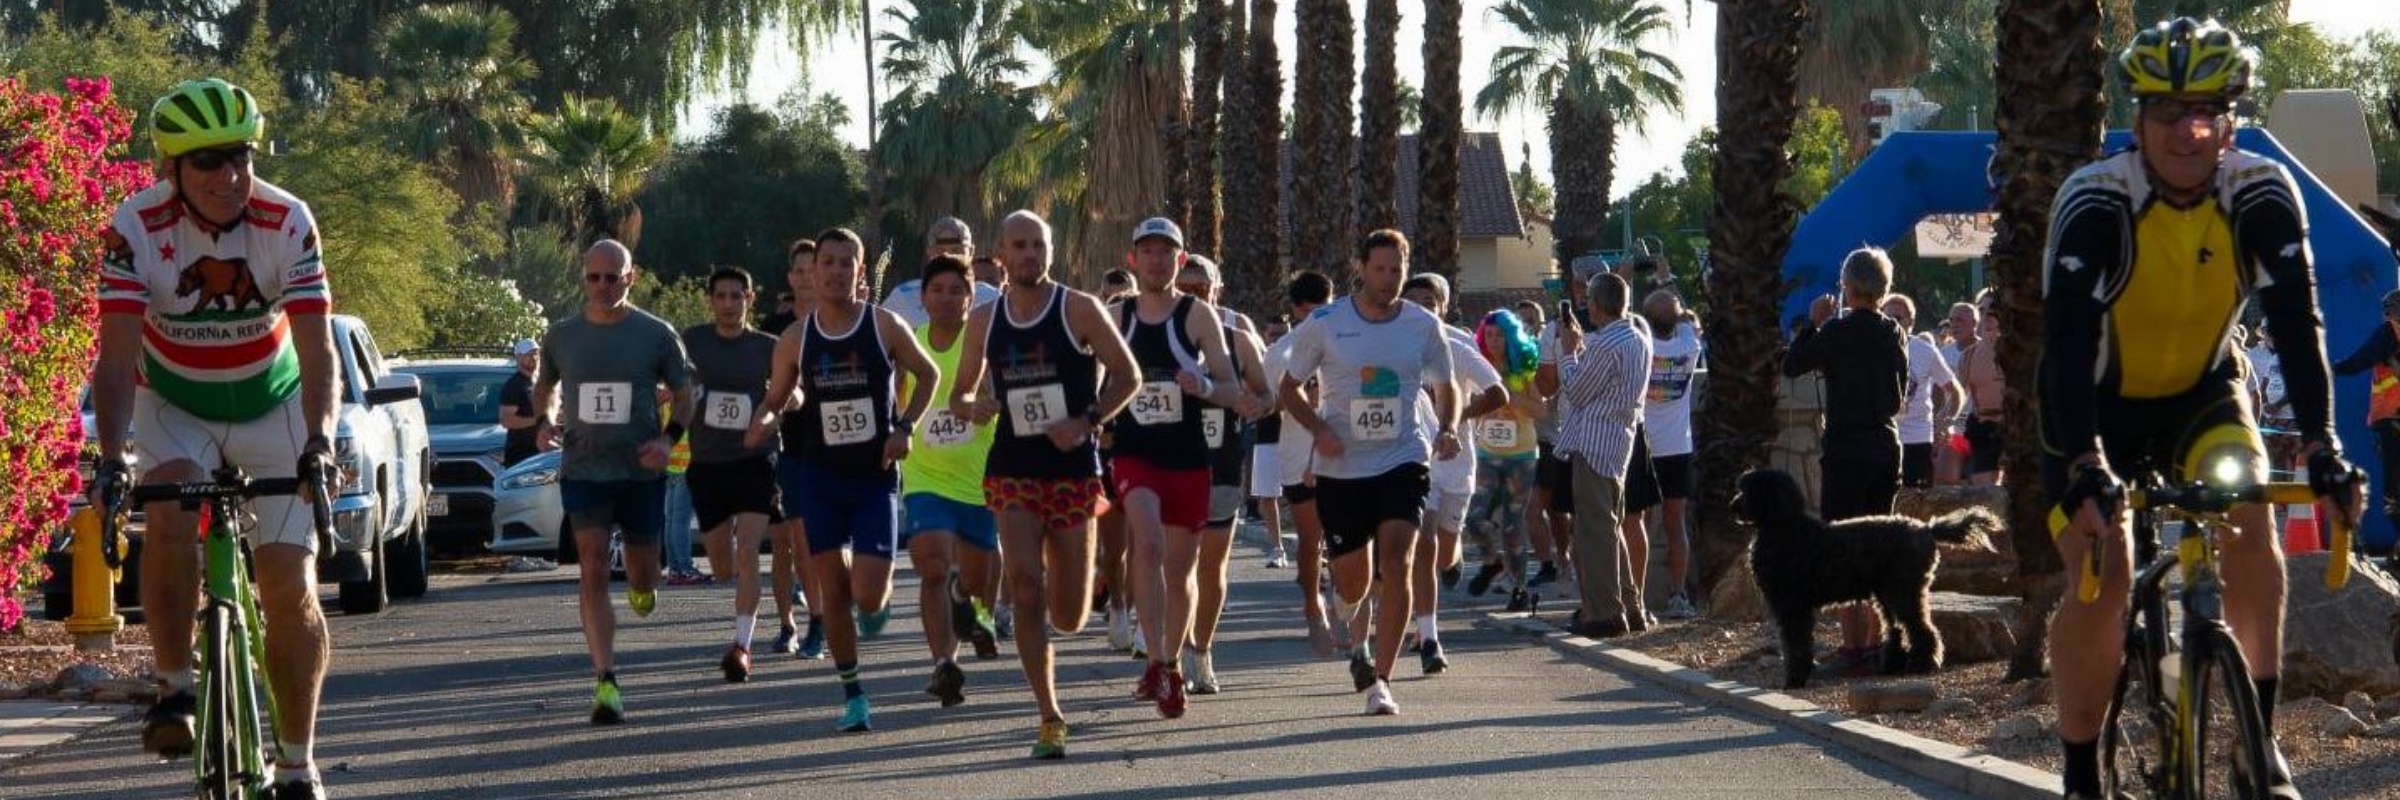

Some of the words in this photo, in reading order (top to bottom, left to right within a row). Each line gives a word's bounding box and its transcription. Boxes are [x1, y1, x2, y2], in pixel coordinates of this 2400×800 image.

[594, 395, 616, 412] 11
[717, 402, 740, 420] 30
[1024, 401, 1050, 422] 81
[1136, 394, 1173, 413] 541
[828, 412, 867, 433] 319
[929, 418, 967, 436] 445
[1357, 410, 1395, 429] 494
